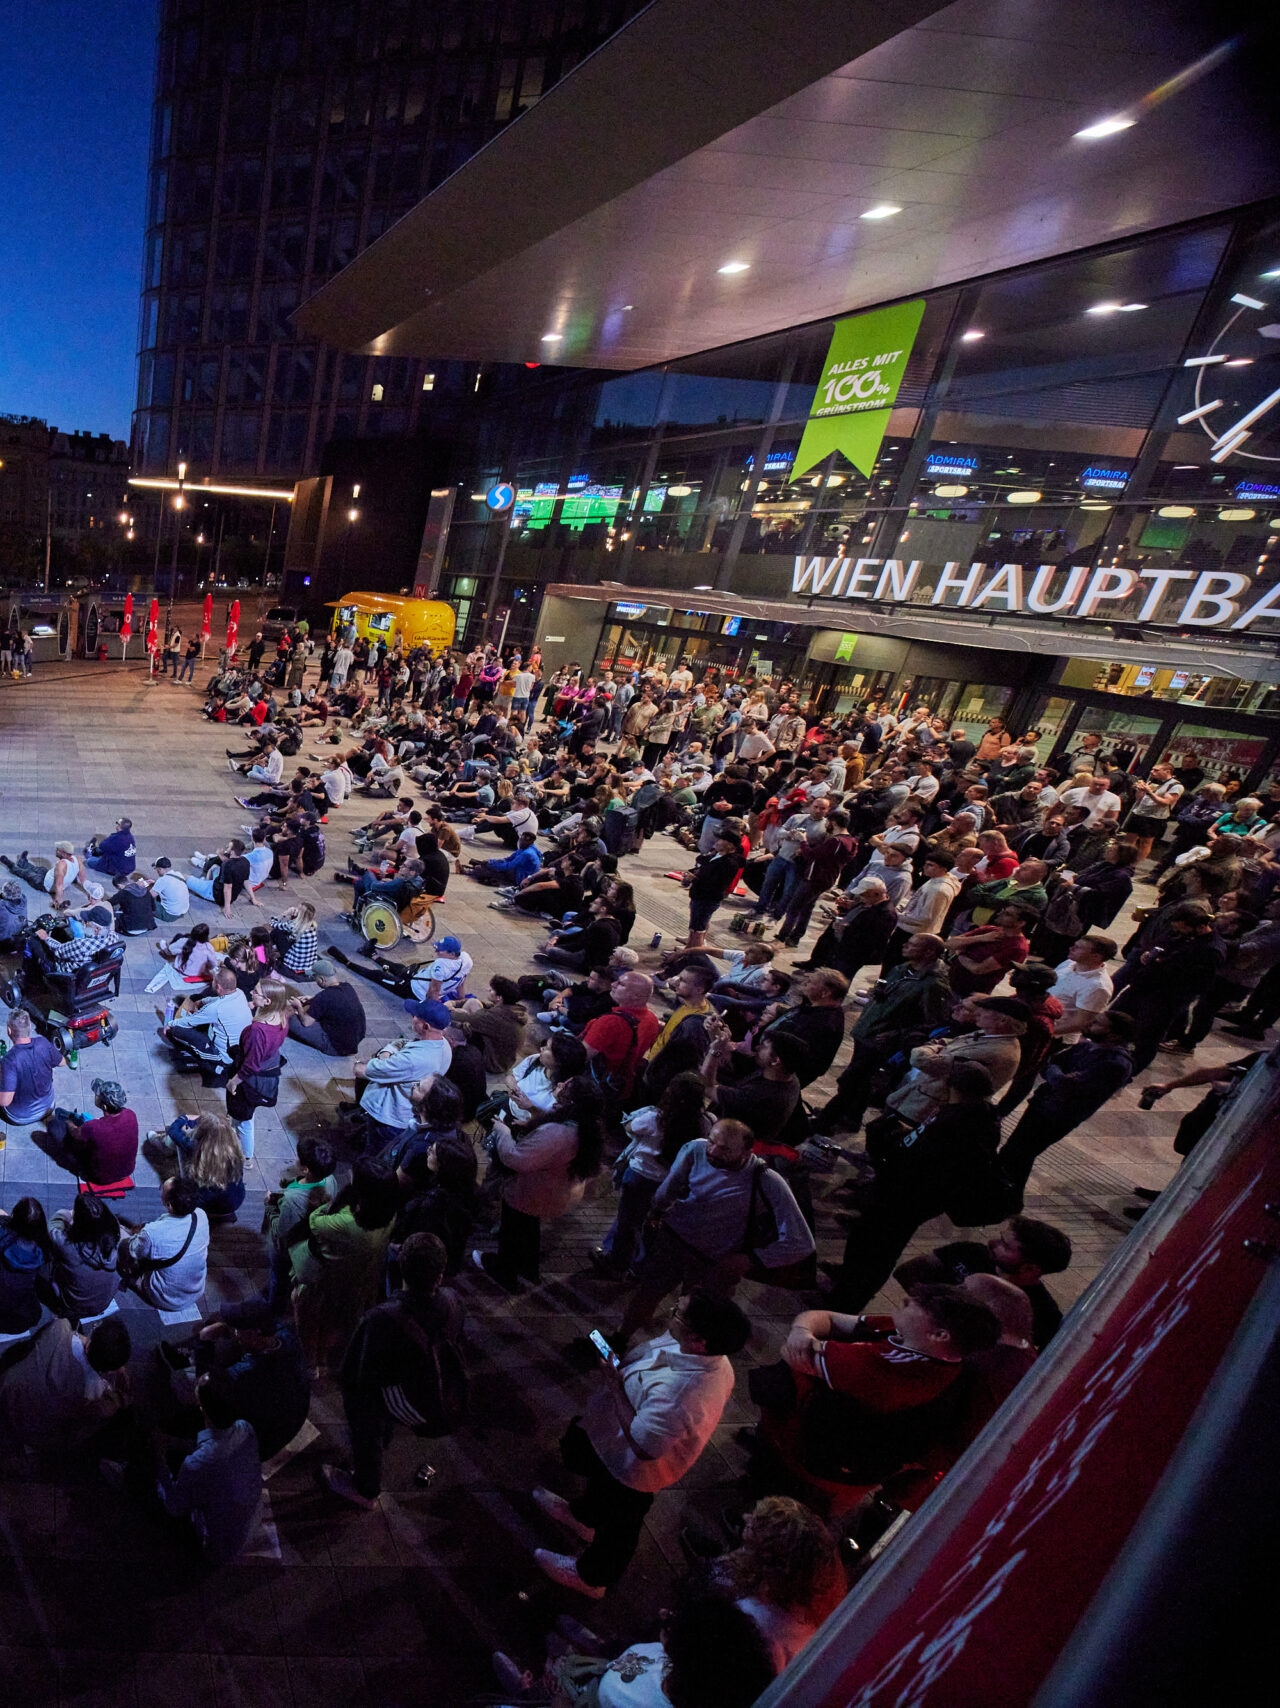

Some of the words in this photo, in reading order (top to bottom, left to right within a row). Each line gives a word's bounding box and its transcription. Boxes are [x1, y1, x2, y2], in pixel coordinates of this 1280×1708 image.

[827, 357, 870, 376] ALLES
[872, 350, 903, 367] MIT
[823, 370, 891, 404] 100%
[816, 398, 887, 416] GRÜNSTROM
[926, 454, 978, 469] ADMIRAL
[927, 465, 972, 475] SPORTSBAR
[1082, 467, 1132, 481] ADMIRA
[1235, 481, 1280, 494] ADMIRA
[792, 556, 919, 601] WIEN
